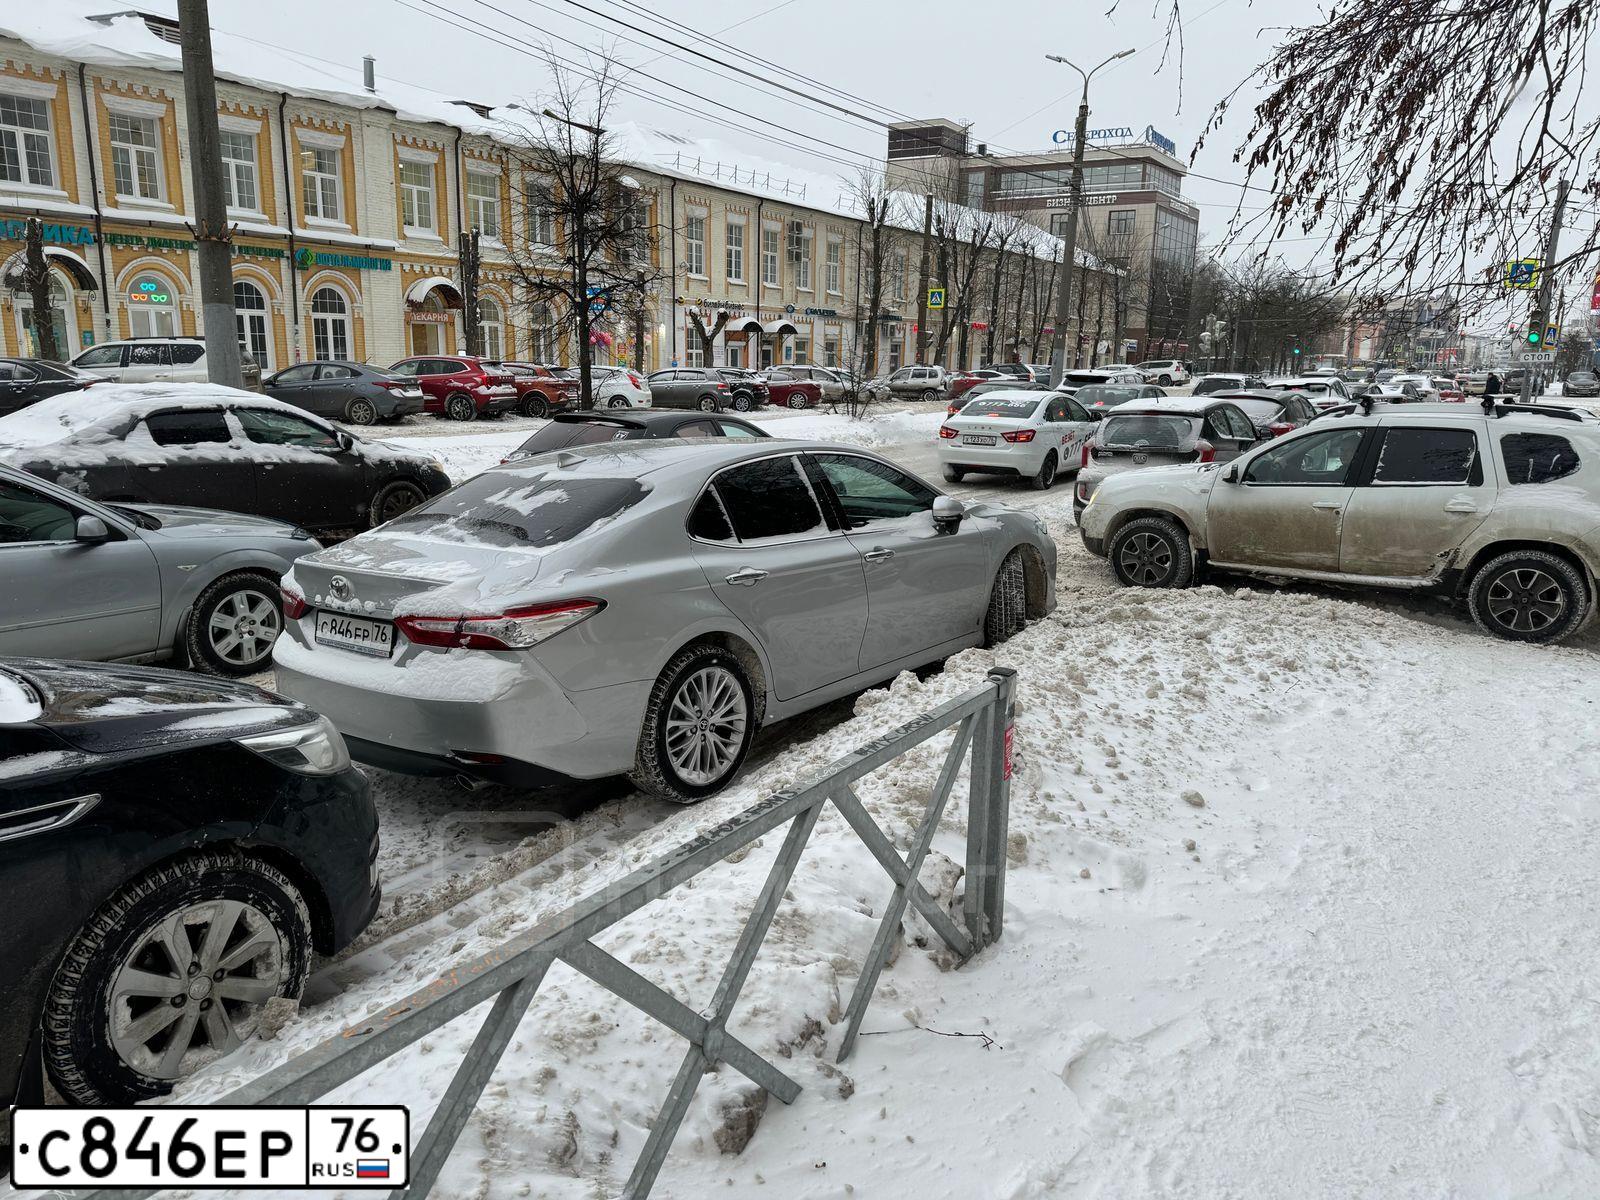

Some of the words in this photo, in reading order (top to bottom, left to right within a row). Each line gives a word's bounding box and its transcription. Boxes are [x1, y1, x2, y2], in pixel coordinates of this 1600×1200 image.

[1052, 127, 1134, 144] СЕЕРОХОД
[1523, 353, 1551, 362] СТОП
[321, 618, 370, 641] С846ЕР
[374, 625, 387, 642] 76
